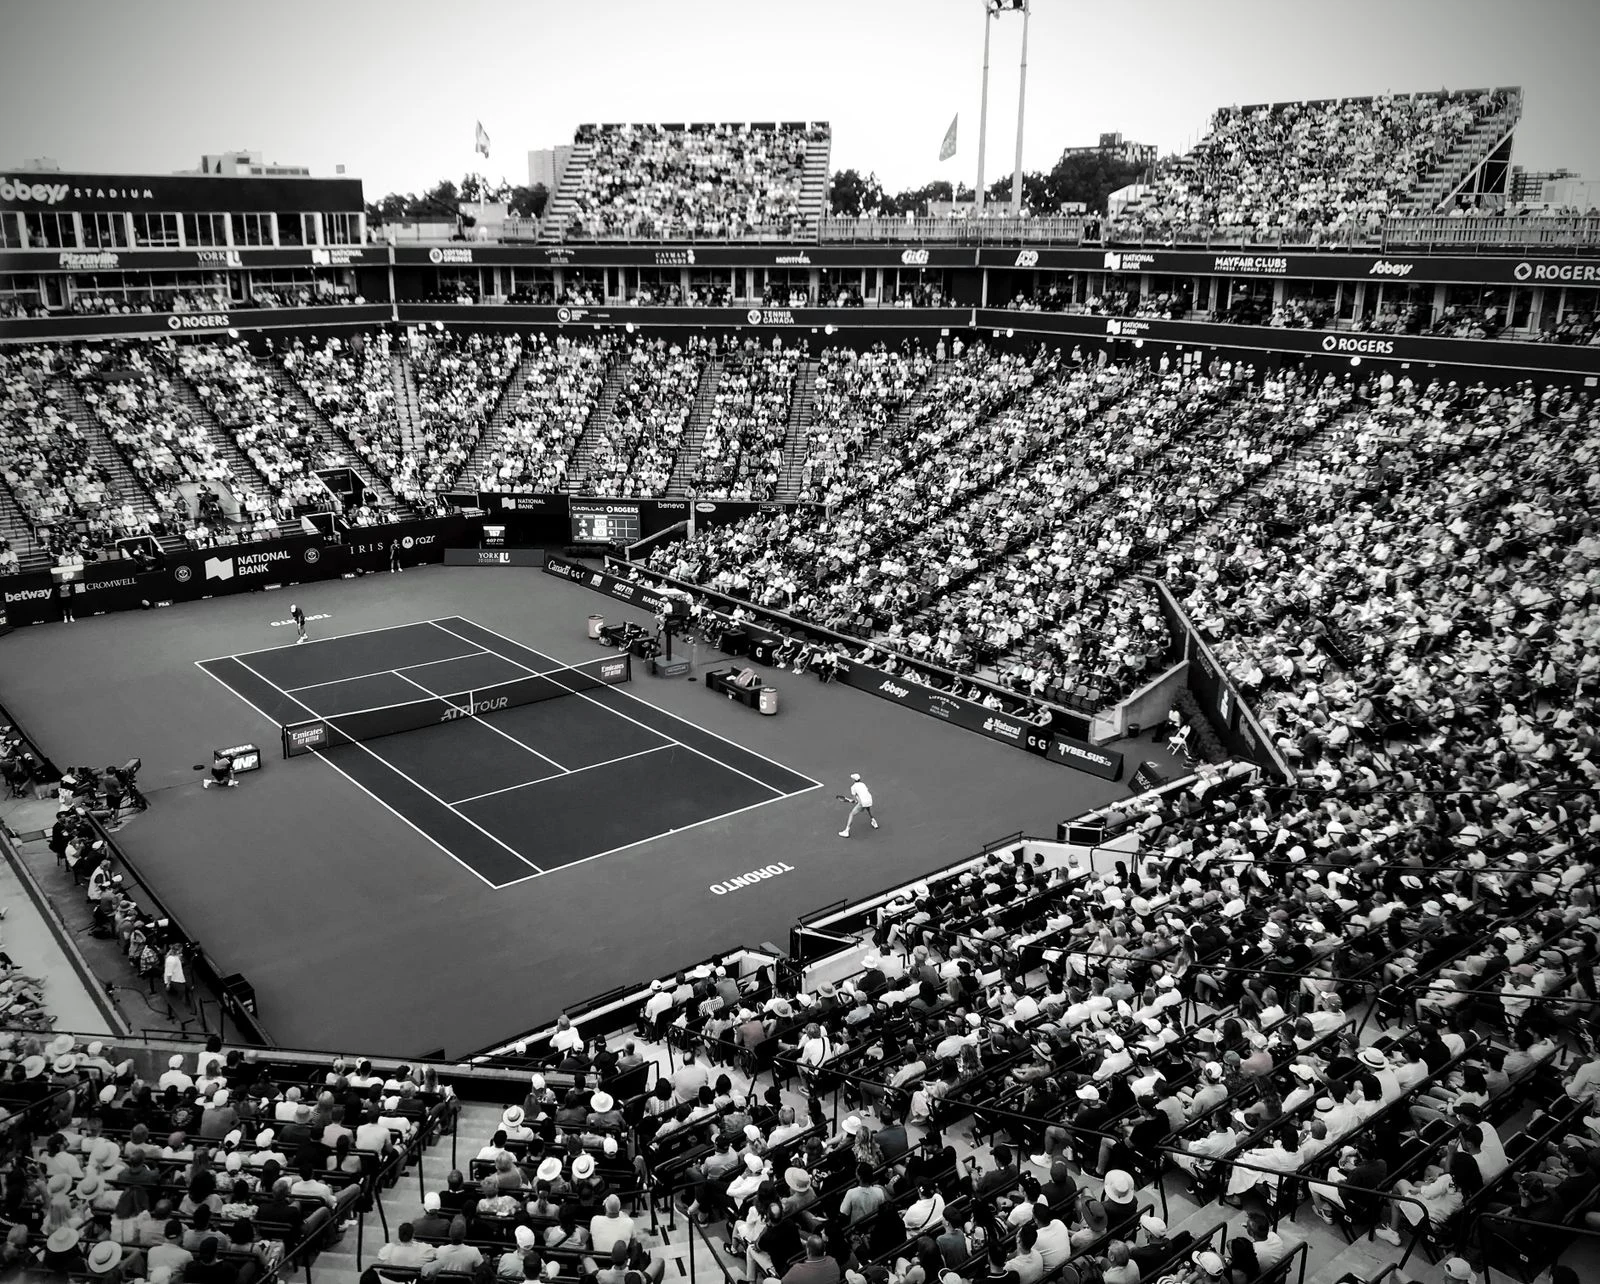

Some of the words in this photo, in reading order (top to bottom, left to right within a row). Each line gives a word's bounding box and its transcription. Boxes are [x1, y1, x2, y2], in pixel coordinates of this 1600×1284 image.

[0, 177, 69, 204] obeys
[74, 188, 153, 198] STADIUM
[197, 251, 226, 261] YORK
[1122, 253, 1154, 262] NATIONAL
[1214, 256, 1254, 267] MAYFAIR
[1254, 257, 1287, 269] CLUBS
[1121, 261, 1140, 269] BANK
[183, 315, 229, 328] ROGERS
[763, 317, 794, 325] CANADA
[1122, 321, 1149, 330] NATIONAL
[1337, 338, 1393, 353] ROGERS
[657, 502, 685, 510] beneva
[415, 535, 436, 546] razr
[350, 542, 384, 555] IRIS
[237, 550, 291, 565] NATIONAL
[238, 563, 269, 576] BANK
[86, 577, 137, 590] CROMWELL
[5, 588, 52, 602] betway
[474, 697, 508, 713] TOUR
[994, 719, 1021, 735] Natural
[292, 728, 324, 740] Emirates
[1028, 736, 1036, 746] G
[1038, 740, 1046, 750] G
[709, 861, 795, 895] TORONTO
